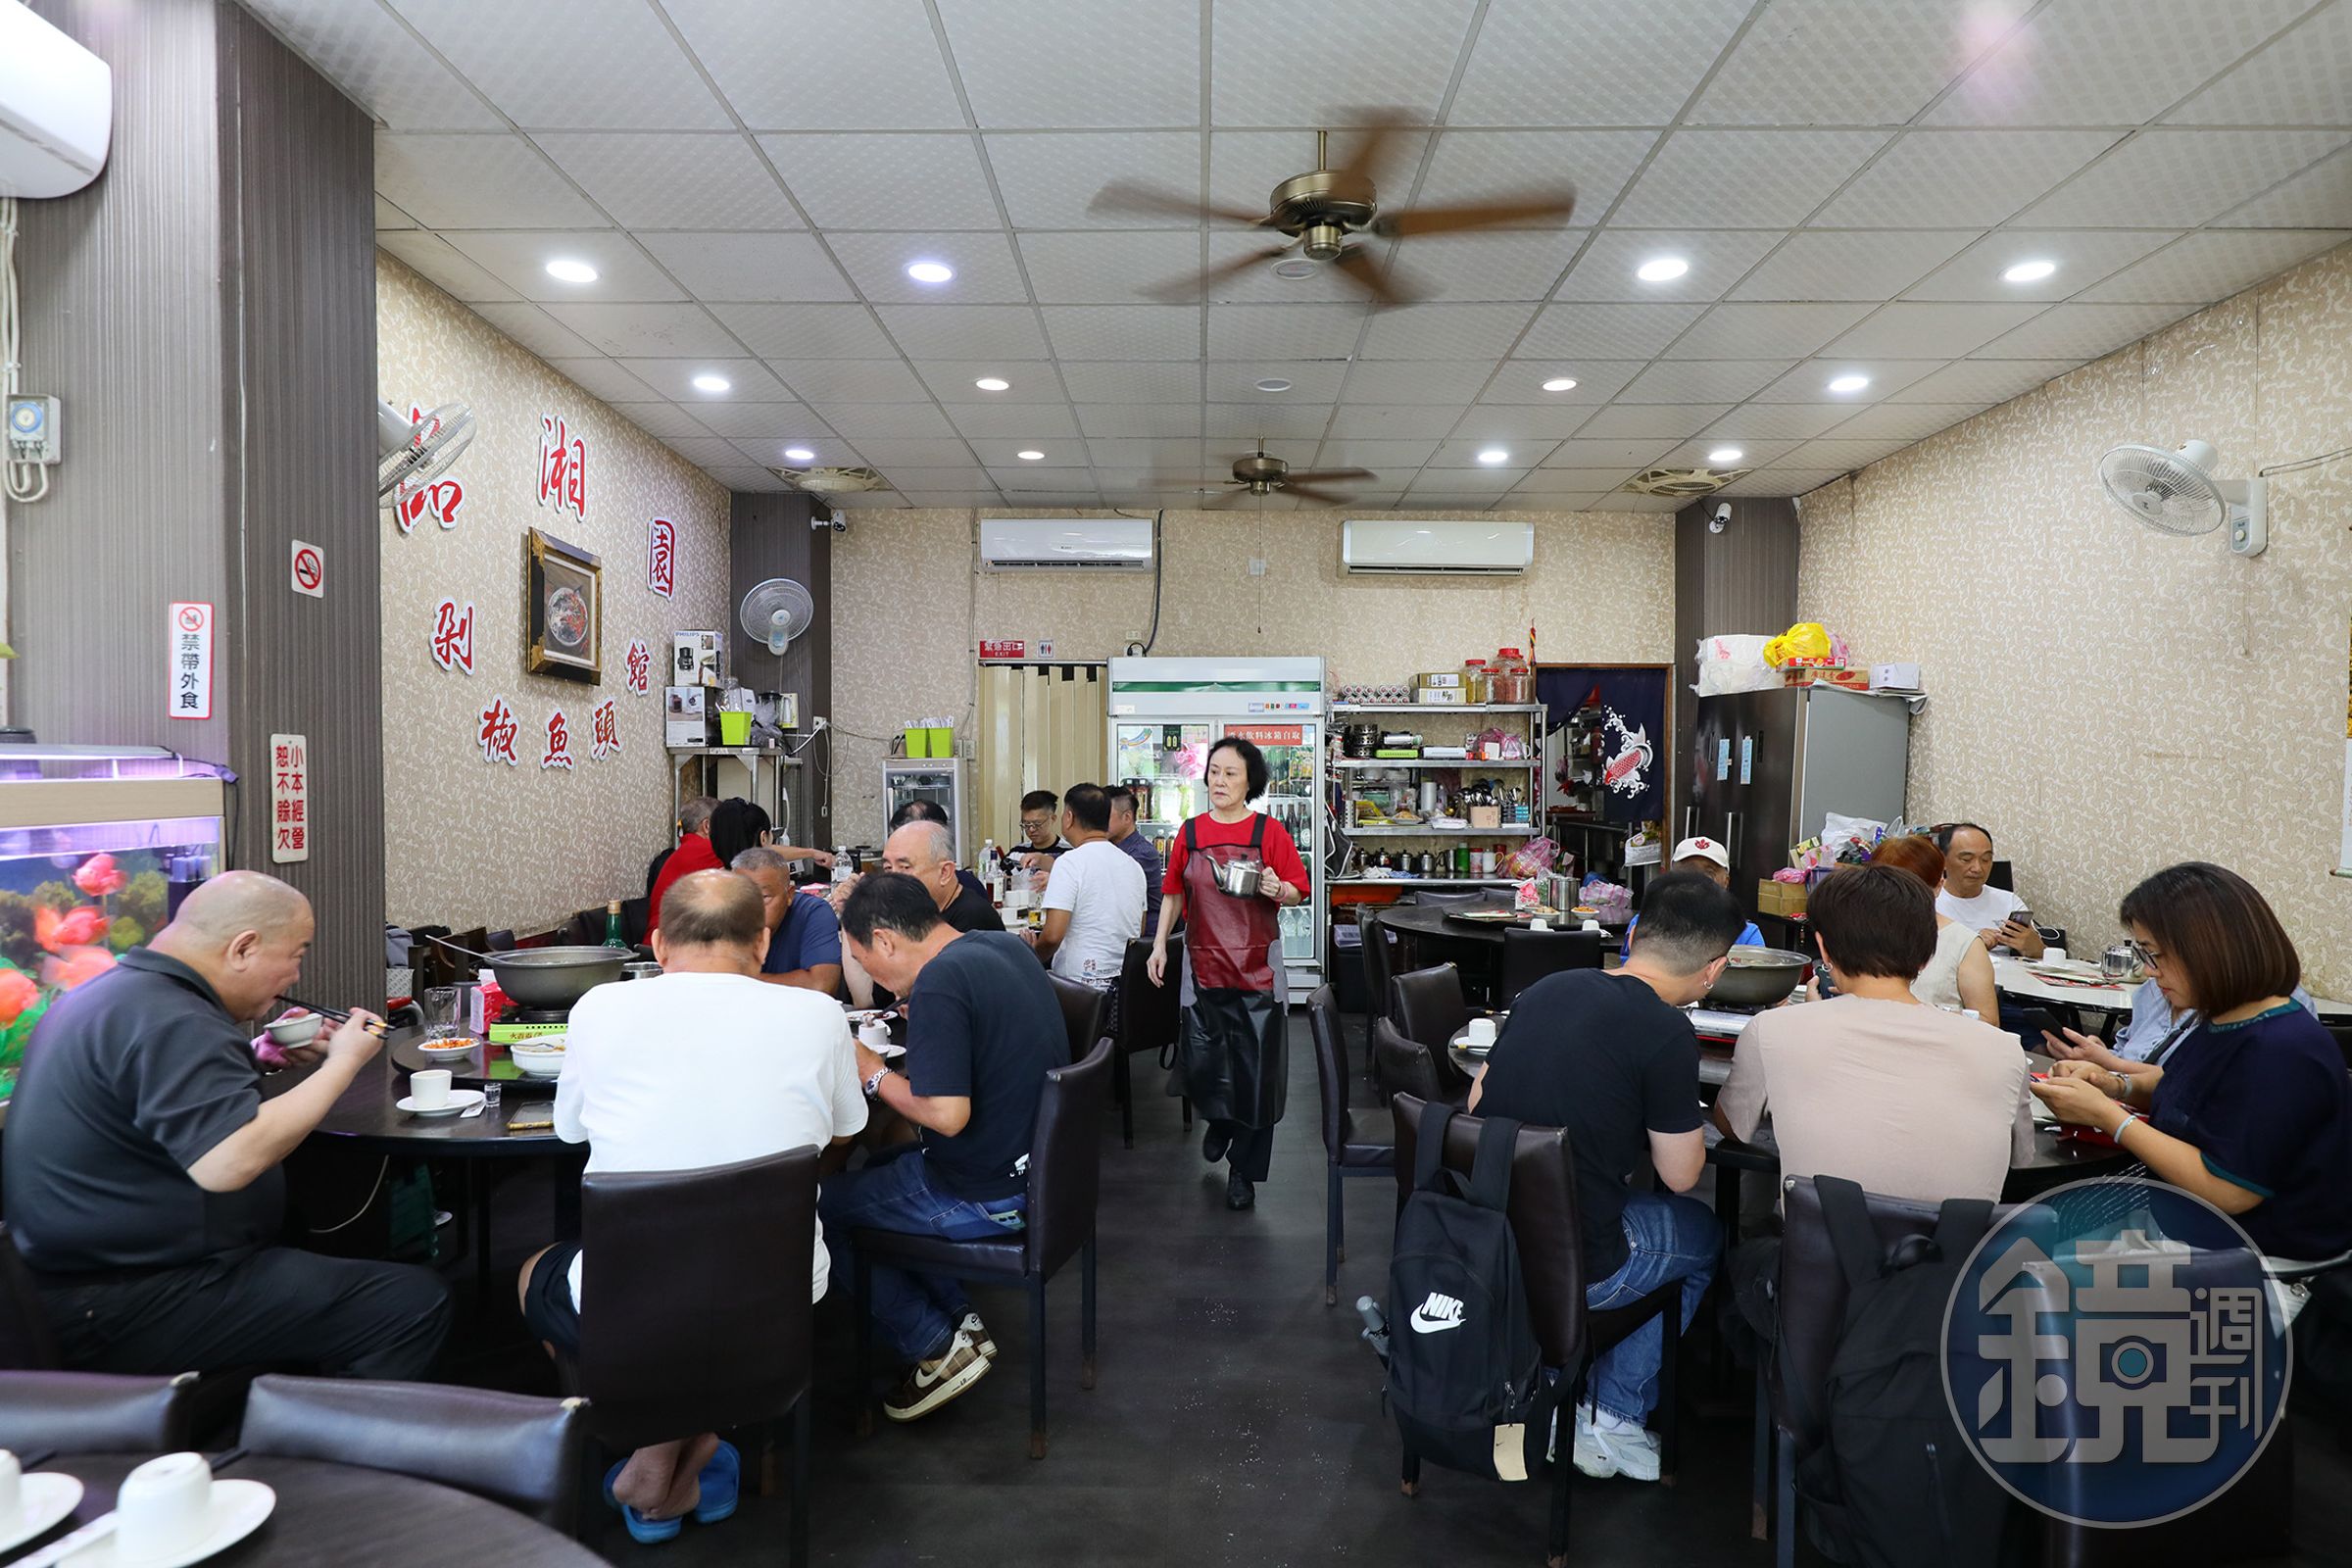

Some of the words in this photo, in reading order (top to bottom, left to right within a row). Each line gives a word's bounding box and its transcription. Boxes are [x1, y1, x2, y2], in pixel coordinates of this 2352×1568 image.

[180, 633, 200, 710] 禁帶外食
[275, 745, 291, 850] 恕不賒欠
[290, 745, 305, 851] 小本經營
[1421, 1292, 1465, 1321] NIKE
